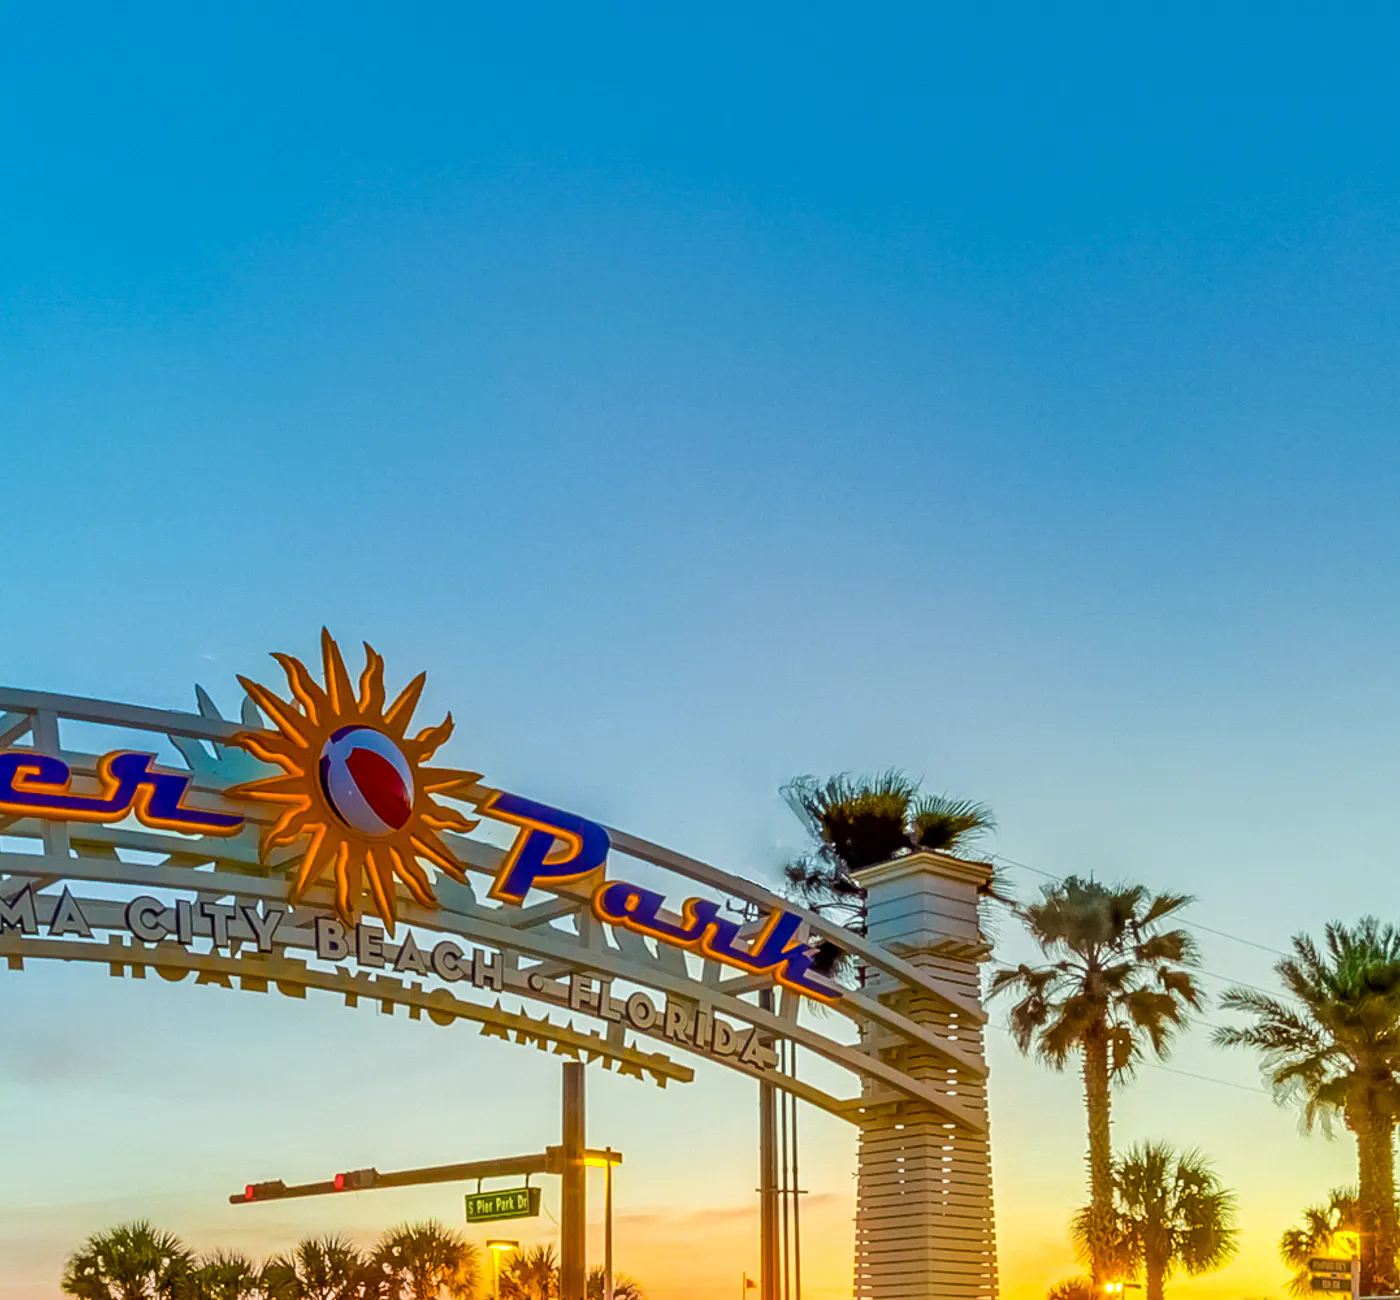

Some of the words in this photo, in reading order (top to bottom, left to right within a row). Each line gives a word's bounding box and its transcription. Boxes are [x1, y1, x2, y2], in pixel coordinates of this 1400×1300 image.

[0, 882, 95, 939] MA
[125, 895, 284, 953] CITY
[314, 916, 504, 992] BEACH
[569, 972, 779, 1070] FLORIDA
[482, 791, 843, 1001] Park
[468, 1200, 474, 1215] S
[495, 1196, 514, 1212] Park
[517, 1194, 527, 1209] Dr
